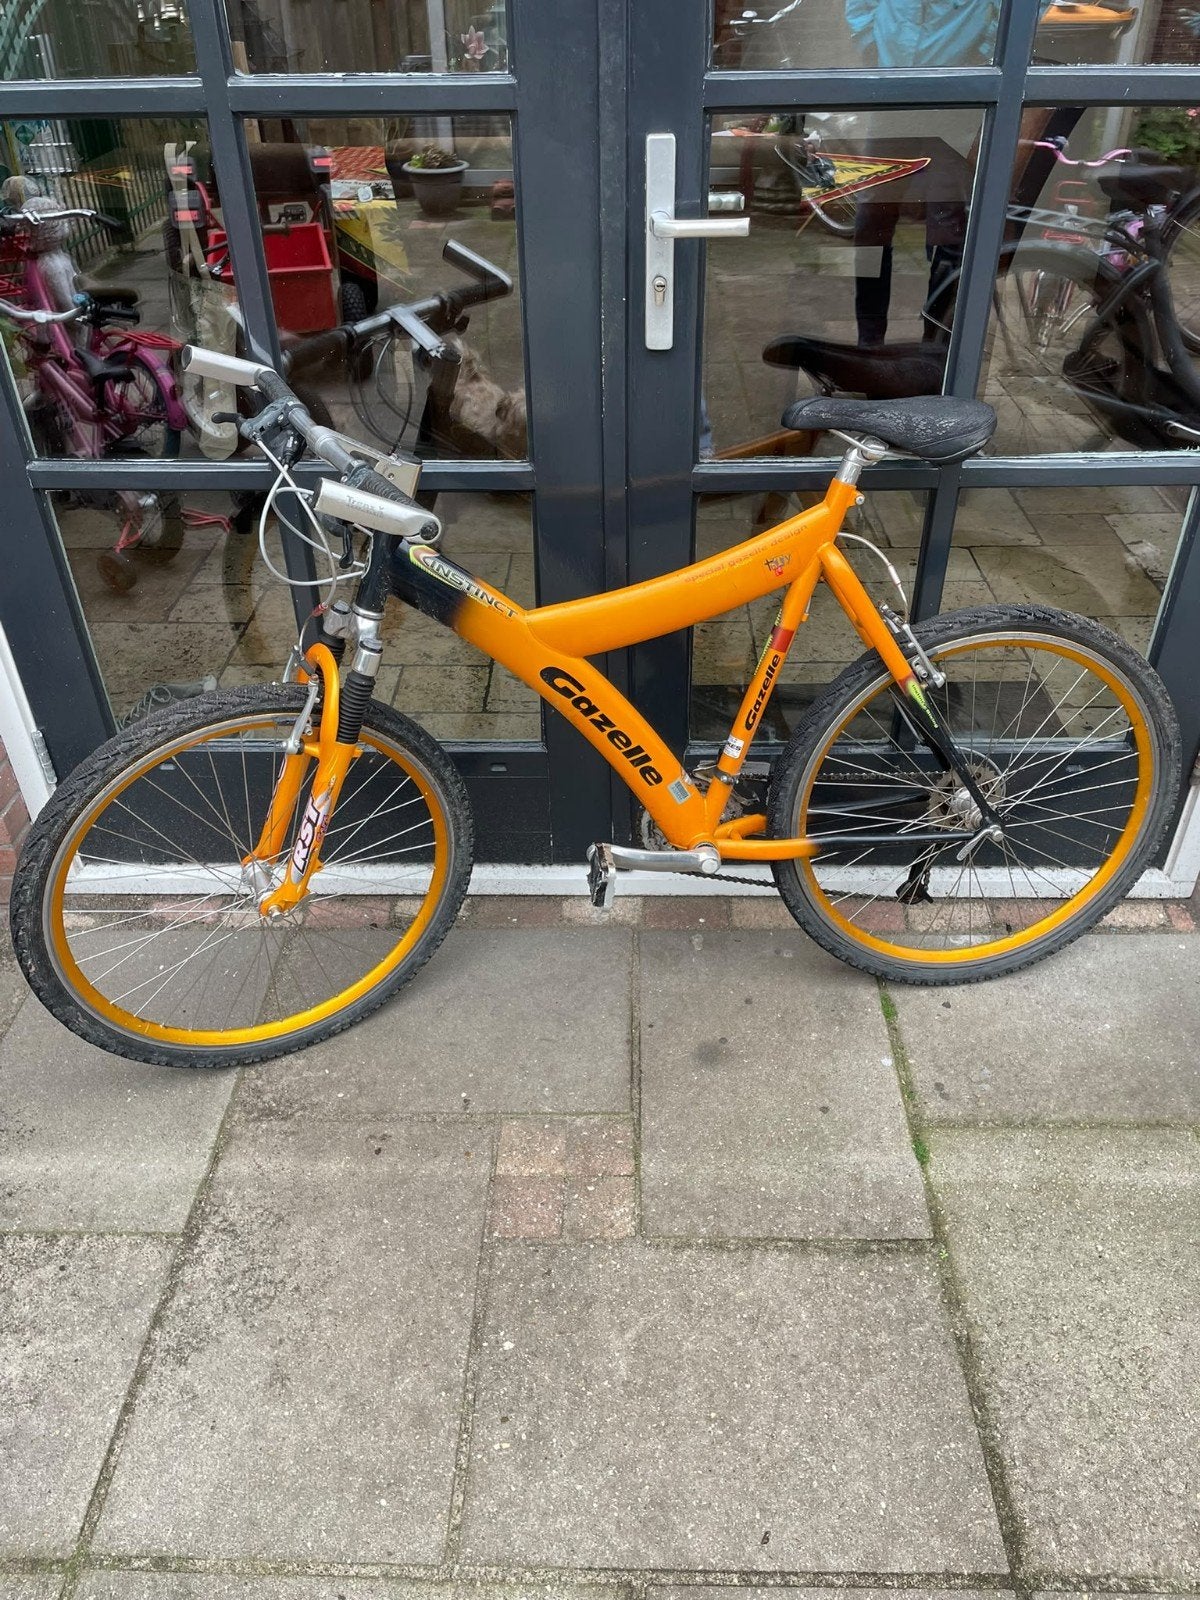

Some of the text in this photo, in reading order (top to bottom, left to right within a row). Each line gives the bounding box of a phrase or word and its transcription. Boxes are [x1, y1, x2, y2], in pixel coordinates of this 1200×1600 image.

[770, 525, 808, 546] design
[430, 560, 519, 618] INSTINCT
[539, 666, 663, 787] Gazelle
[744, 653, 781, 731] Gazelle
[293, 794, 321, 875] RST
